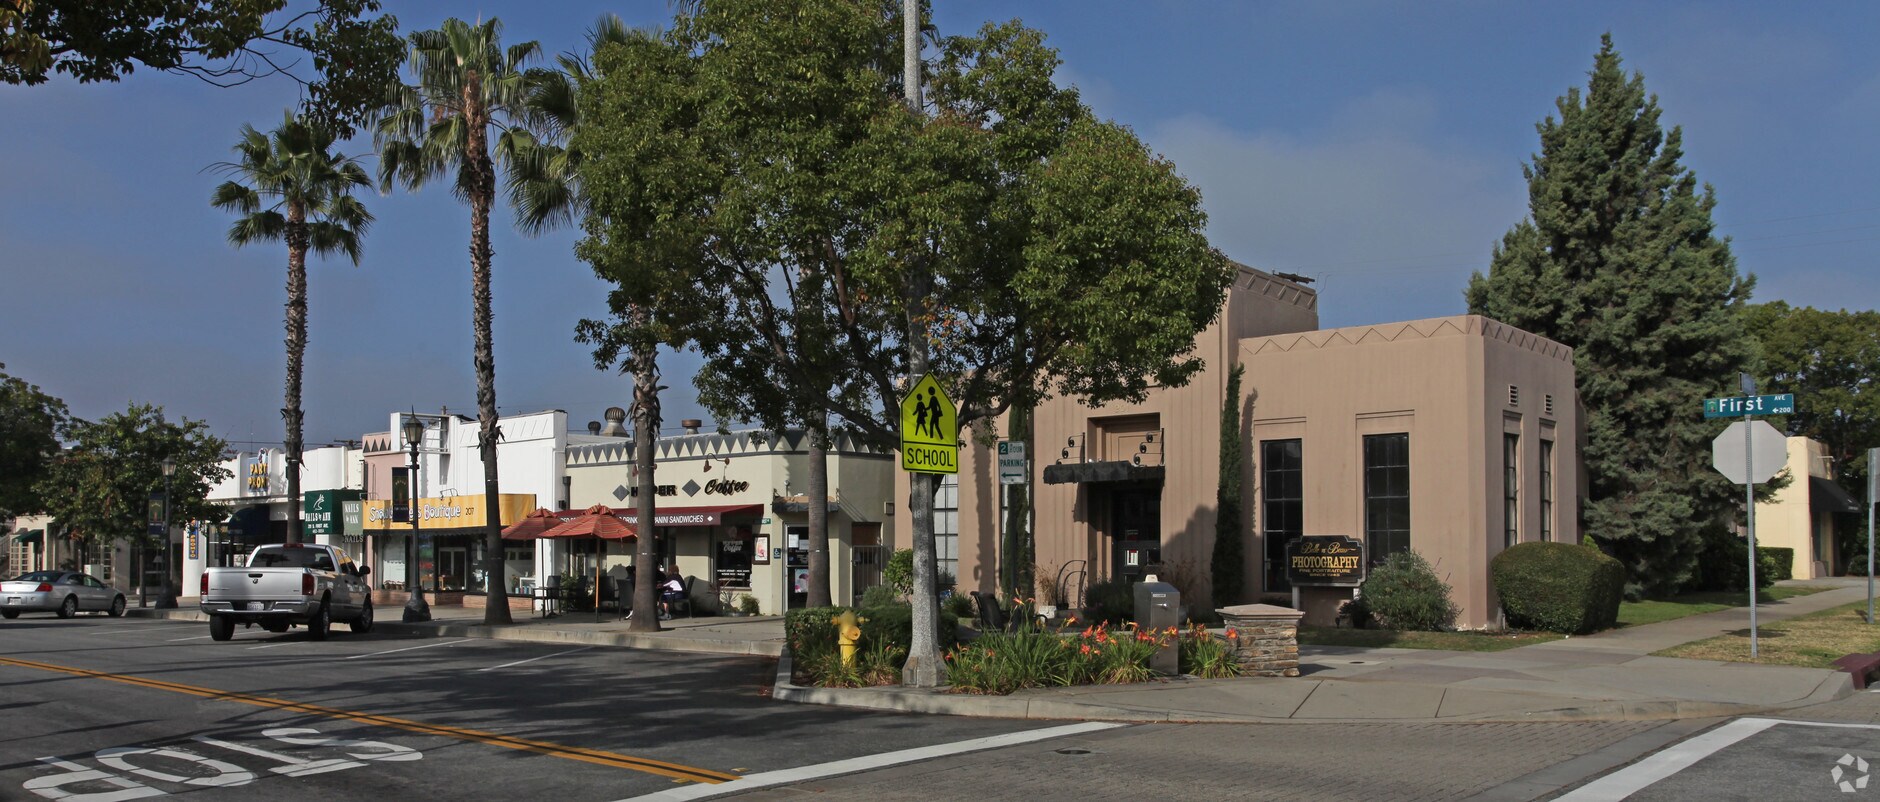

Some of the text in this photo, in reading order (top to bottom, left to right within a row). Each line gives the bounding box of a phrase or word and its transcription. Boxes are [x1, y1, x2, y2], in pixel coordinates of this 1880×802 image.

[1719, 396, 1764, 413] First
[1000, 444, 1007, 453] 2
[907, 447, 954, 467] SCHOOL
[1000, 458, 1024, 467] PARKING
[250, 463, 267, 474] PART
[704, 479, 749, 496] Coffee
[345, 503, 359, 513] NAILS
[424, 504, 461, 520] Boutique
[465, 507, 474, 515] 207
[305, 512, 318, 522] NAILS
[654, 516, 669, 524] ANINI
[669, 514, 704, 524] SANDWICHES
[344, 535, 363, 543] NAILS
[1291, 556, 1359, 568] PHOTOGRAPHY
[22, 727, 423, 802] STOP
